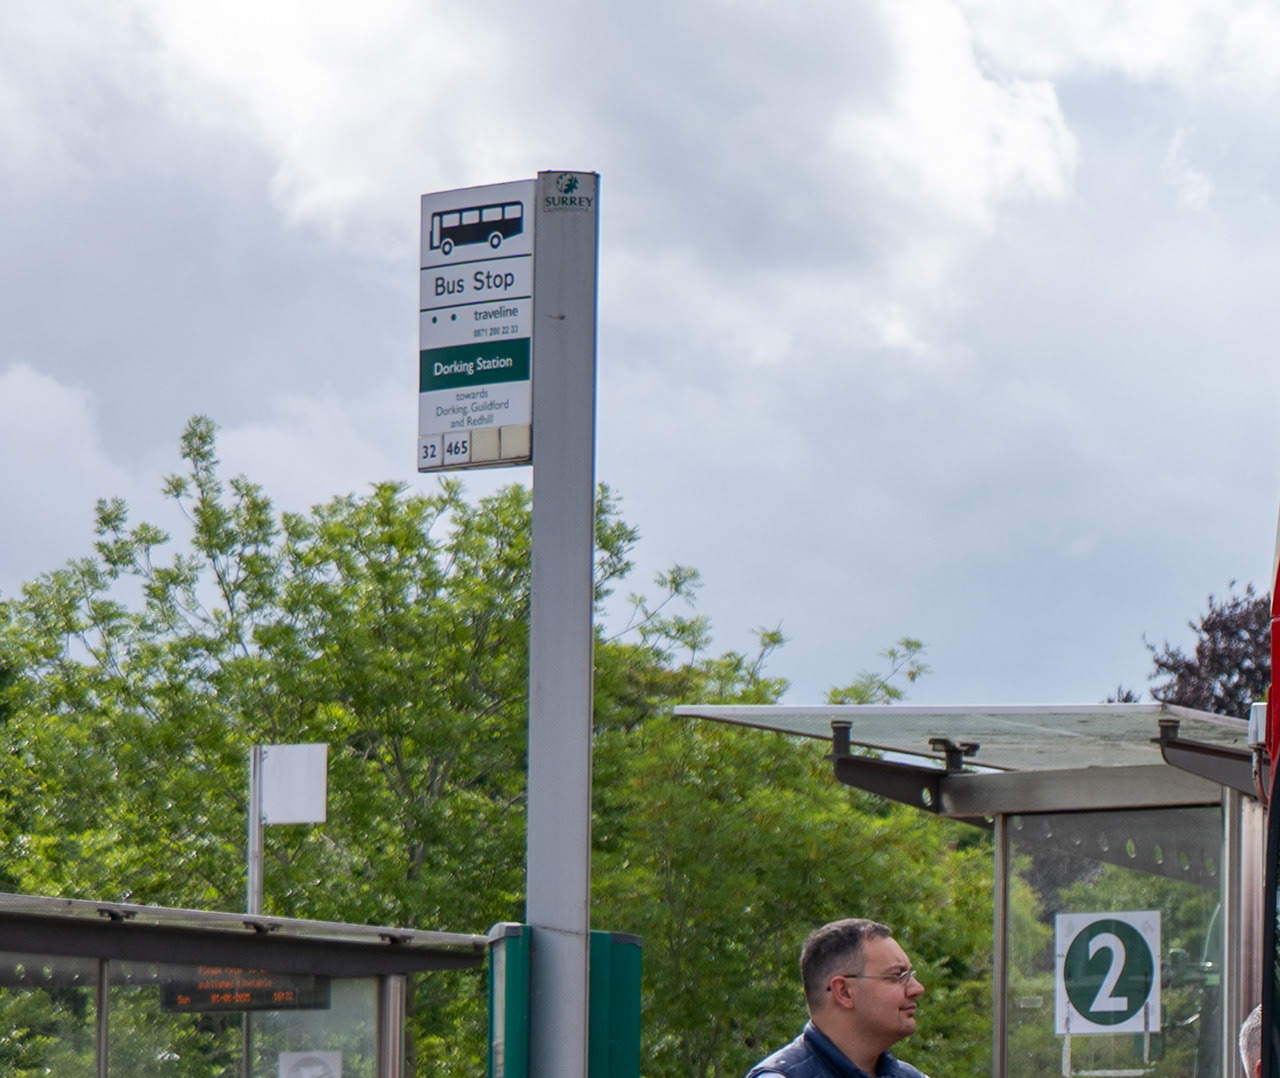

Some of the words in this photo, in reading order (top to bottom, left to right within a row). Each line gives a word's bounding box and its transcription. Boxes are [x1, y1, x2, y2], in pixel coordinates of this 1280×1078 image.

[545, 196, 593, 207] SURREY
[435, 276, 465, 296] Bus
[473, 270, 515, 291] Stop
[474, 306, 519, 321] traveline
[474, 328, 488, 338] 0871
[489, 327, 501, 336] 200
[501, 325, 510, 335] 22
[511, 325, 519, 334] 33
[434, 361, 474, 376] Dorking
[476, 356, 513, 371] Station
[456, 388, 489, 401] towards
[470, 399, 510, 413] Guildford
[450, 419, 465, 428] and
[467, 414, 495, 427] Redhill
[422, 444, 437, 459] 32
[446, 440, 468, 455] 465
[1088, 932, 1129, 1012] 2
